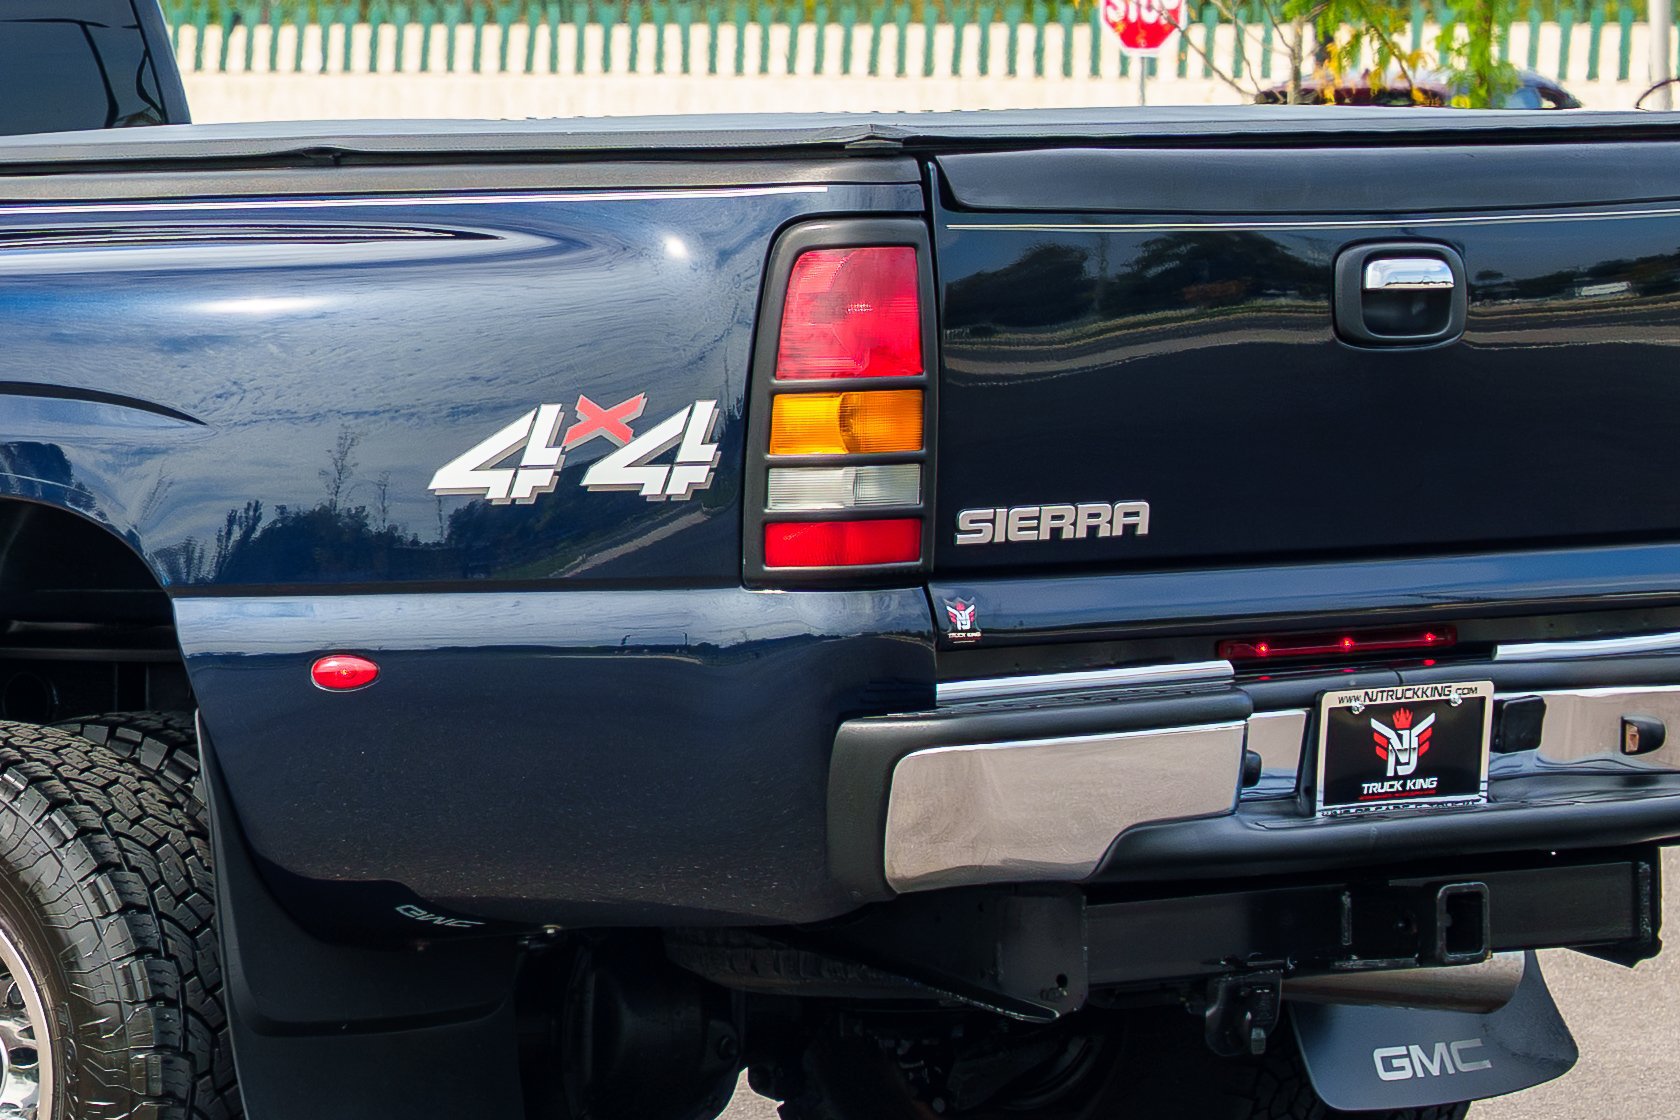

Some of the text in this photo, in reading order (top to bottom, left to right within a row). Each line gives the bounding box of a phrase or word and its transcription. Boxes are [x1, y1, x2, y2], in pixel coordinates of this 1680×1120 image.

[954, 500, 1150, 545] SIERRA
[1361, 777, 1438, 794] TRUCK KING
[395, 904, 486, 928] GMC
[1373, 1038, 1493, 1081] GMC
